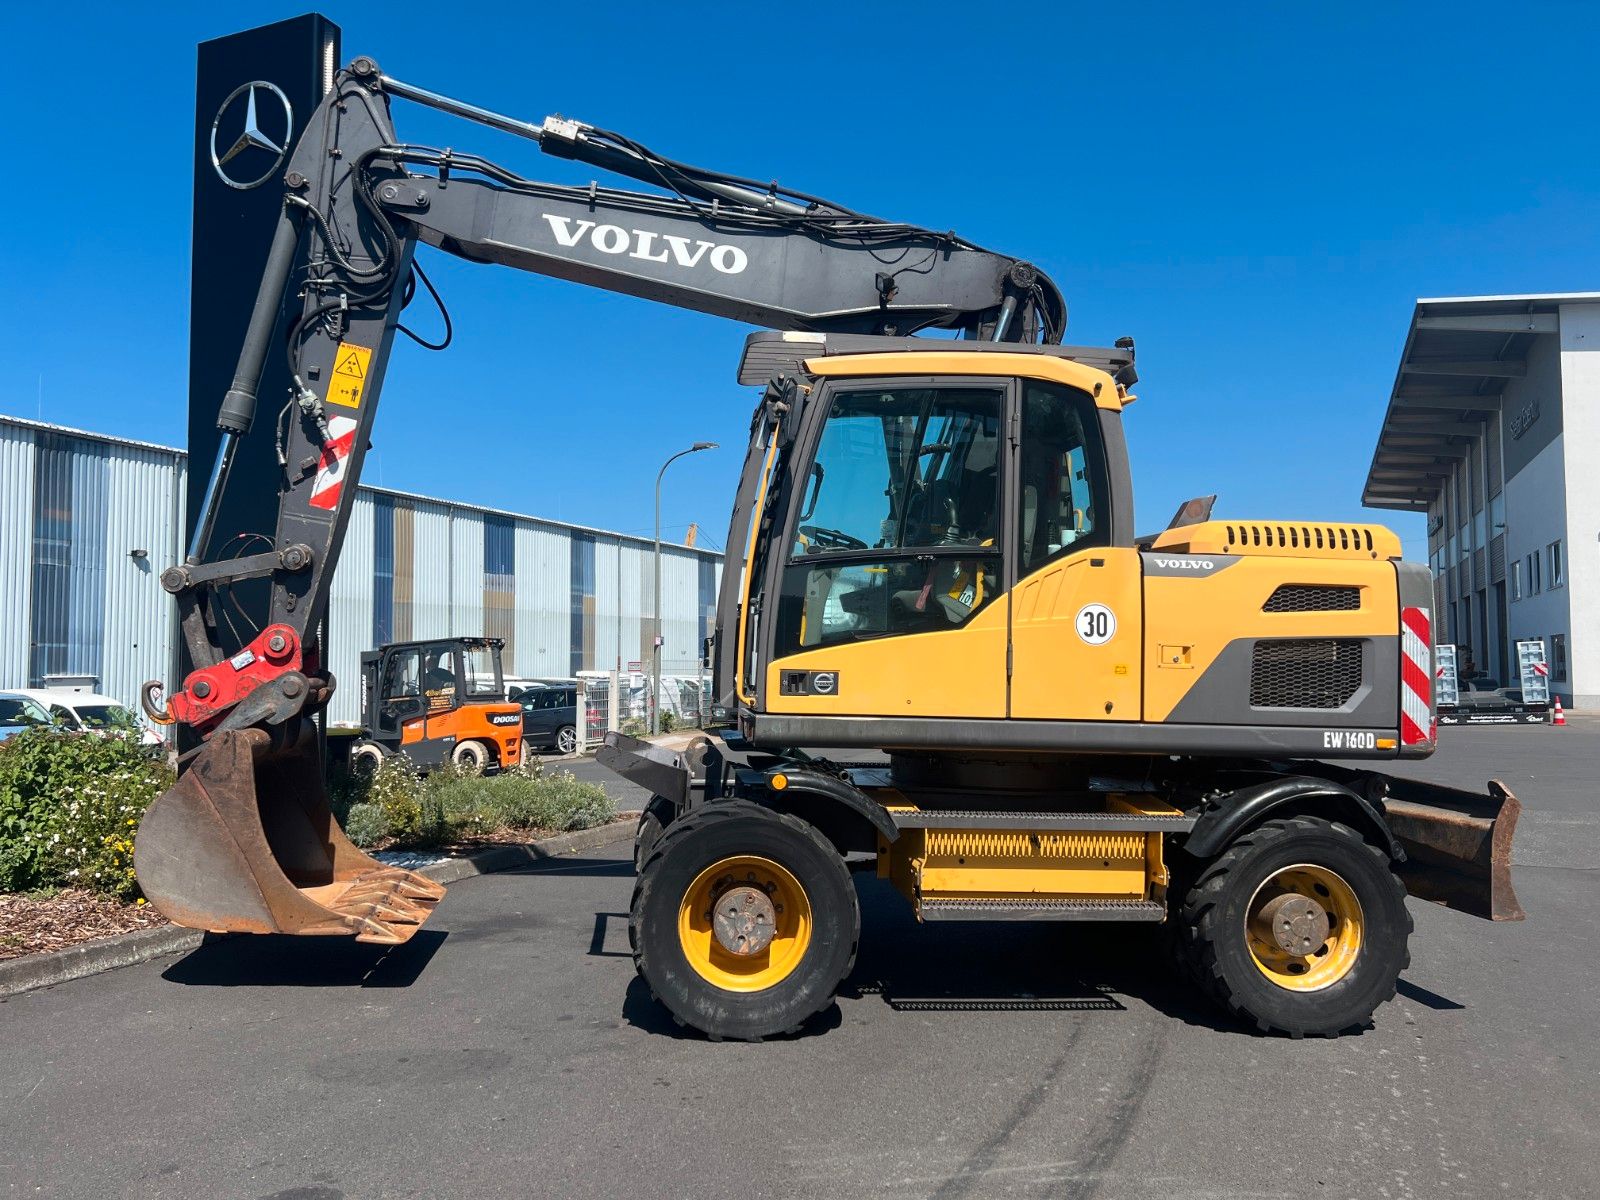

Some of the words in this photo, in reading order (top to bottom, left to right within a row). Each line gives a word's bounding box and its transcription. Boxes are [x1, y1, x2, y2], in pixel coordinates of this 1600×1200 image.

[542, 213, 748, 274] VOLVO
[1154, 559, 1214, 569] VOLVO
[1083, 611, 1107, 638] 30
